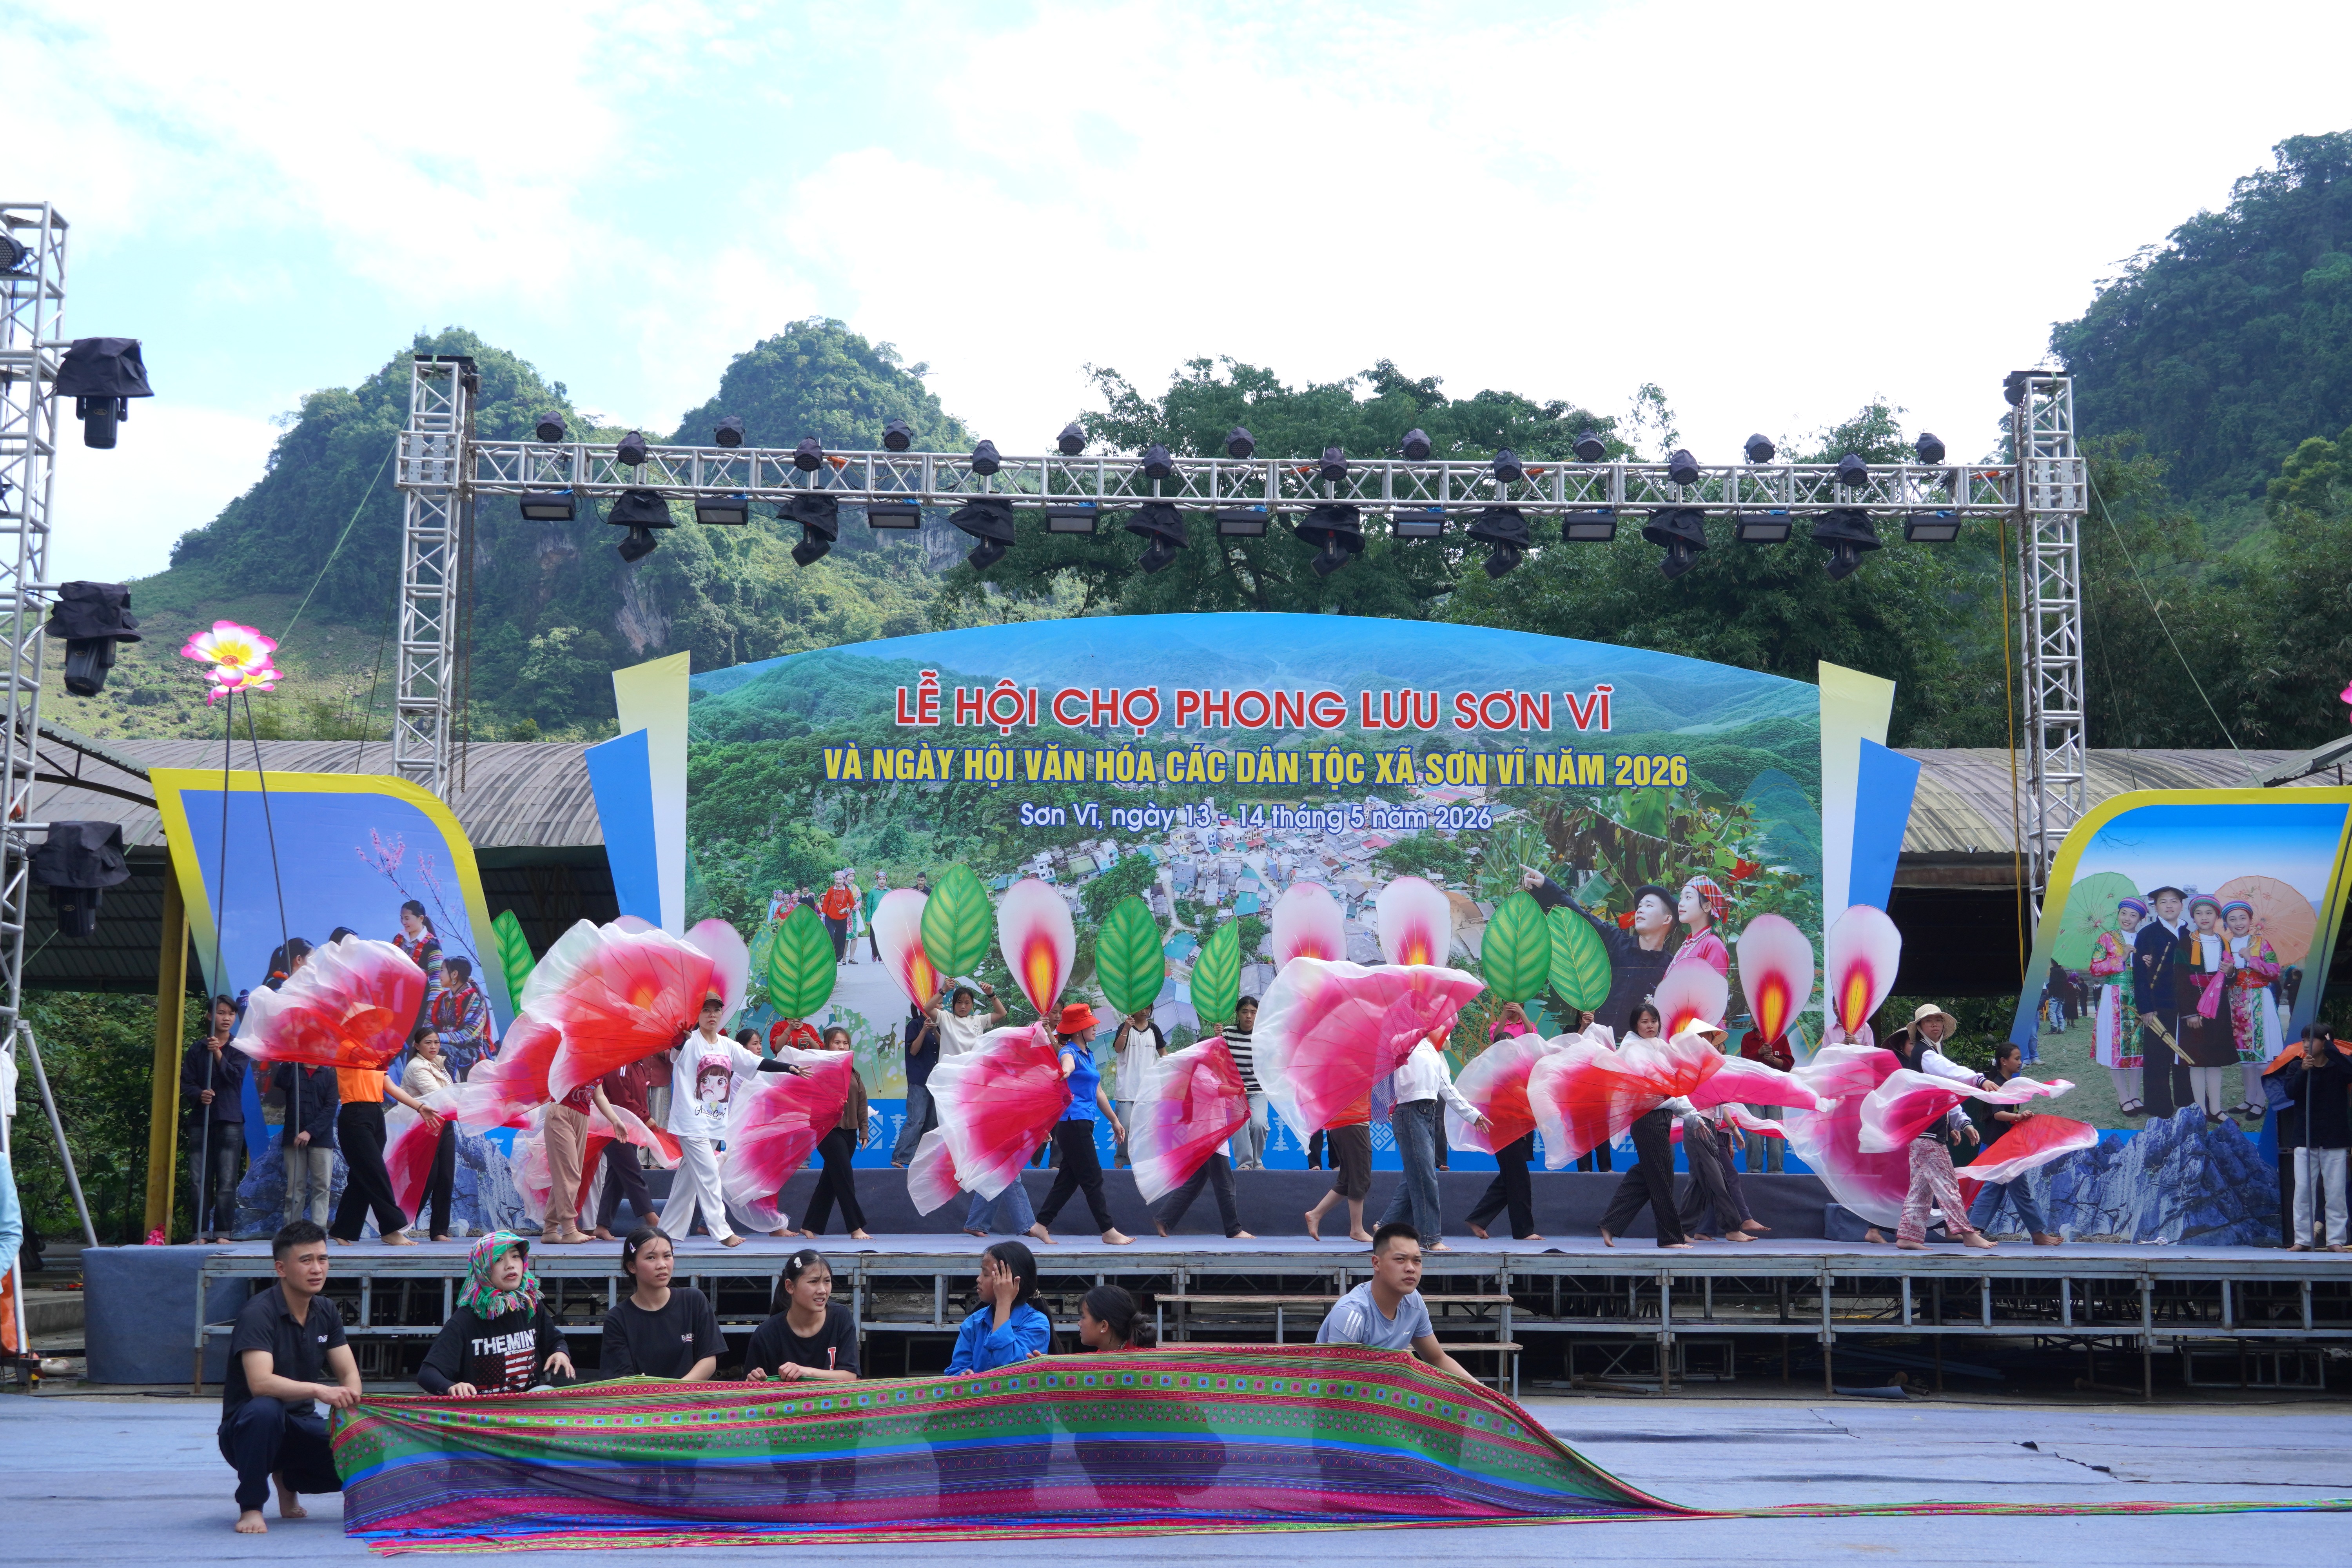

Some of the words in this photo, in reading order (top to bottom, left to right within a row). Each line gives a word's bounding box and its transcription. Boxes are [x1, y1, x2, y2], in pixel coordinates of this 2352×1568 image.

[897, 670, 939, 724] LỄ
[955, 679, 1037, 735] HỘI
[1053, 687, 1160, 736] CHỢ
[1176, 690, 1347, 729] PHONG
[1362, 689, 1439, 730] LƯU
[1454, 690, 1550, 730] SƠN
[1566, 685, 1613, 730] VĨ
[824, 742, 863, 780] VÀ
[872, 742, 955, 780] NGÀY
[964, 742, 1014, 788] HỘI
[1024, 743, 1085, 781] VĂN
[1095, 744, 1156, 782] HÓA
[1166, 744, 1226, 783] CÁC
[1236, 745, 1299, 783] DÂN
[1308, 746, 1365, 791] TỘC
[1375, 746, 1416, 784] XÃ
[1425, 750, 1487, 785] SƠN
[1496, 748, 1526, 785] VĨ
[1535, 748, 1605, 786] NĂM
[1615, 755, 1688, 787] 2026
[1020, 801, 1065, 826] Sơn
[1073, 802, 1104, 829] Vĩ,
[1111, 801, 1176, 832] ngày
[1185, 804, 1212, 828] 13
[1239, 804, 1266, 828] 14
[1271, 802, 1345, 835] tháng
[1349, 806, 1365, 829] 5
[1372, 805, 1428, 829] năm
[1435, 806, 1493, 830] 2026
[472, 1328, 537, 1356] THEMIN'
